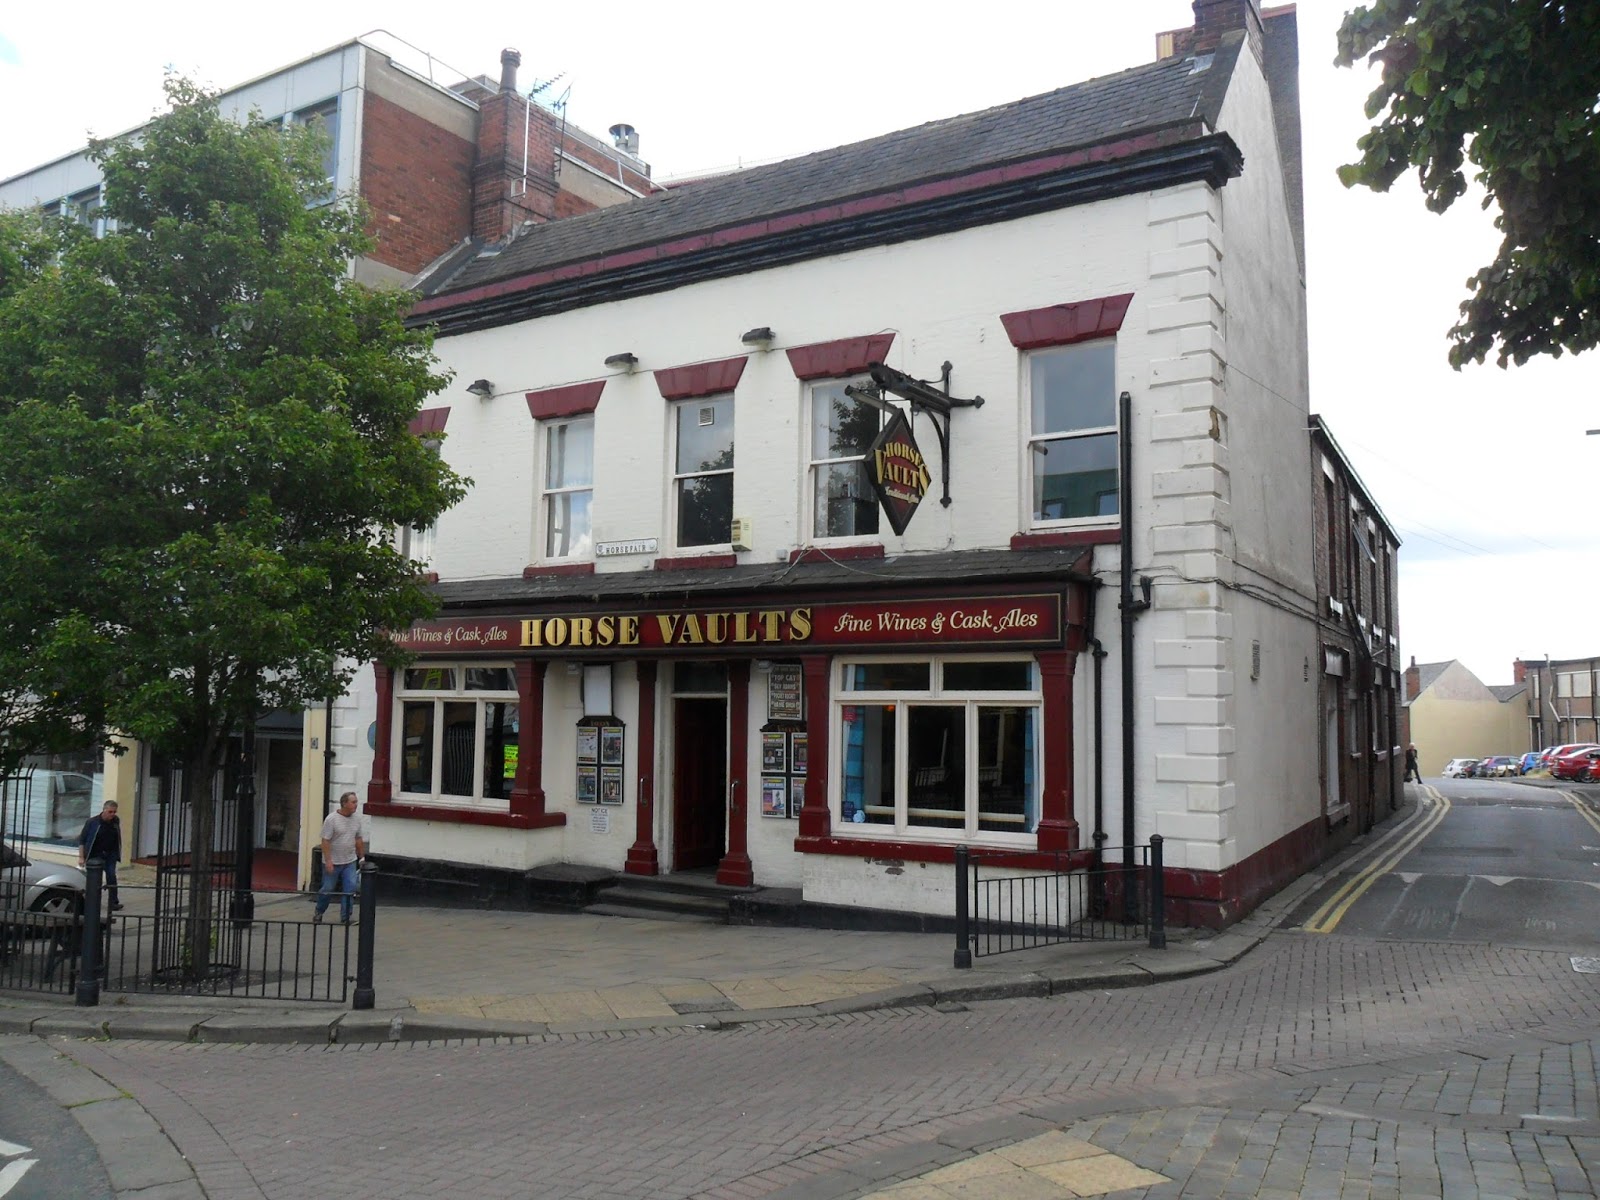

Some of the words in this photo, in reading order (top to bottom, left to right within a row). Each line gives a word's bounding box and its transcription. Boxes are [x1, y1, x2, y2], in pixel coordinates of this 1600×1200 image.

[885, 442, 922, 465] HORSE
[875, 449, 928, 497] VAULTS
[519, 616, 639, 646] HORSE
[656, 608, 812, 644] VAULTS
[834, 612, 872, 632] Fine
[877, 611, 927, 631] Wines
[931, 612, 946, 634] &
[950, 610, 993, 629] Cask
[992, 608, 1038, 633] Ales
[413, 627, 442, 642] Wines
[444, 628, 453, 645] &
[455, 626, 481, 641] Cask
[481, 626, 508, 645] Ales
